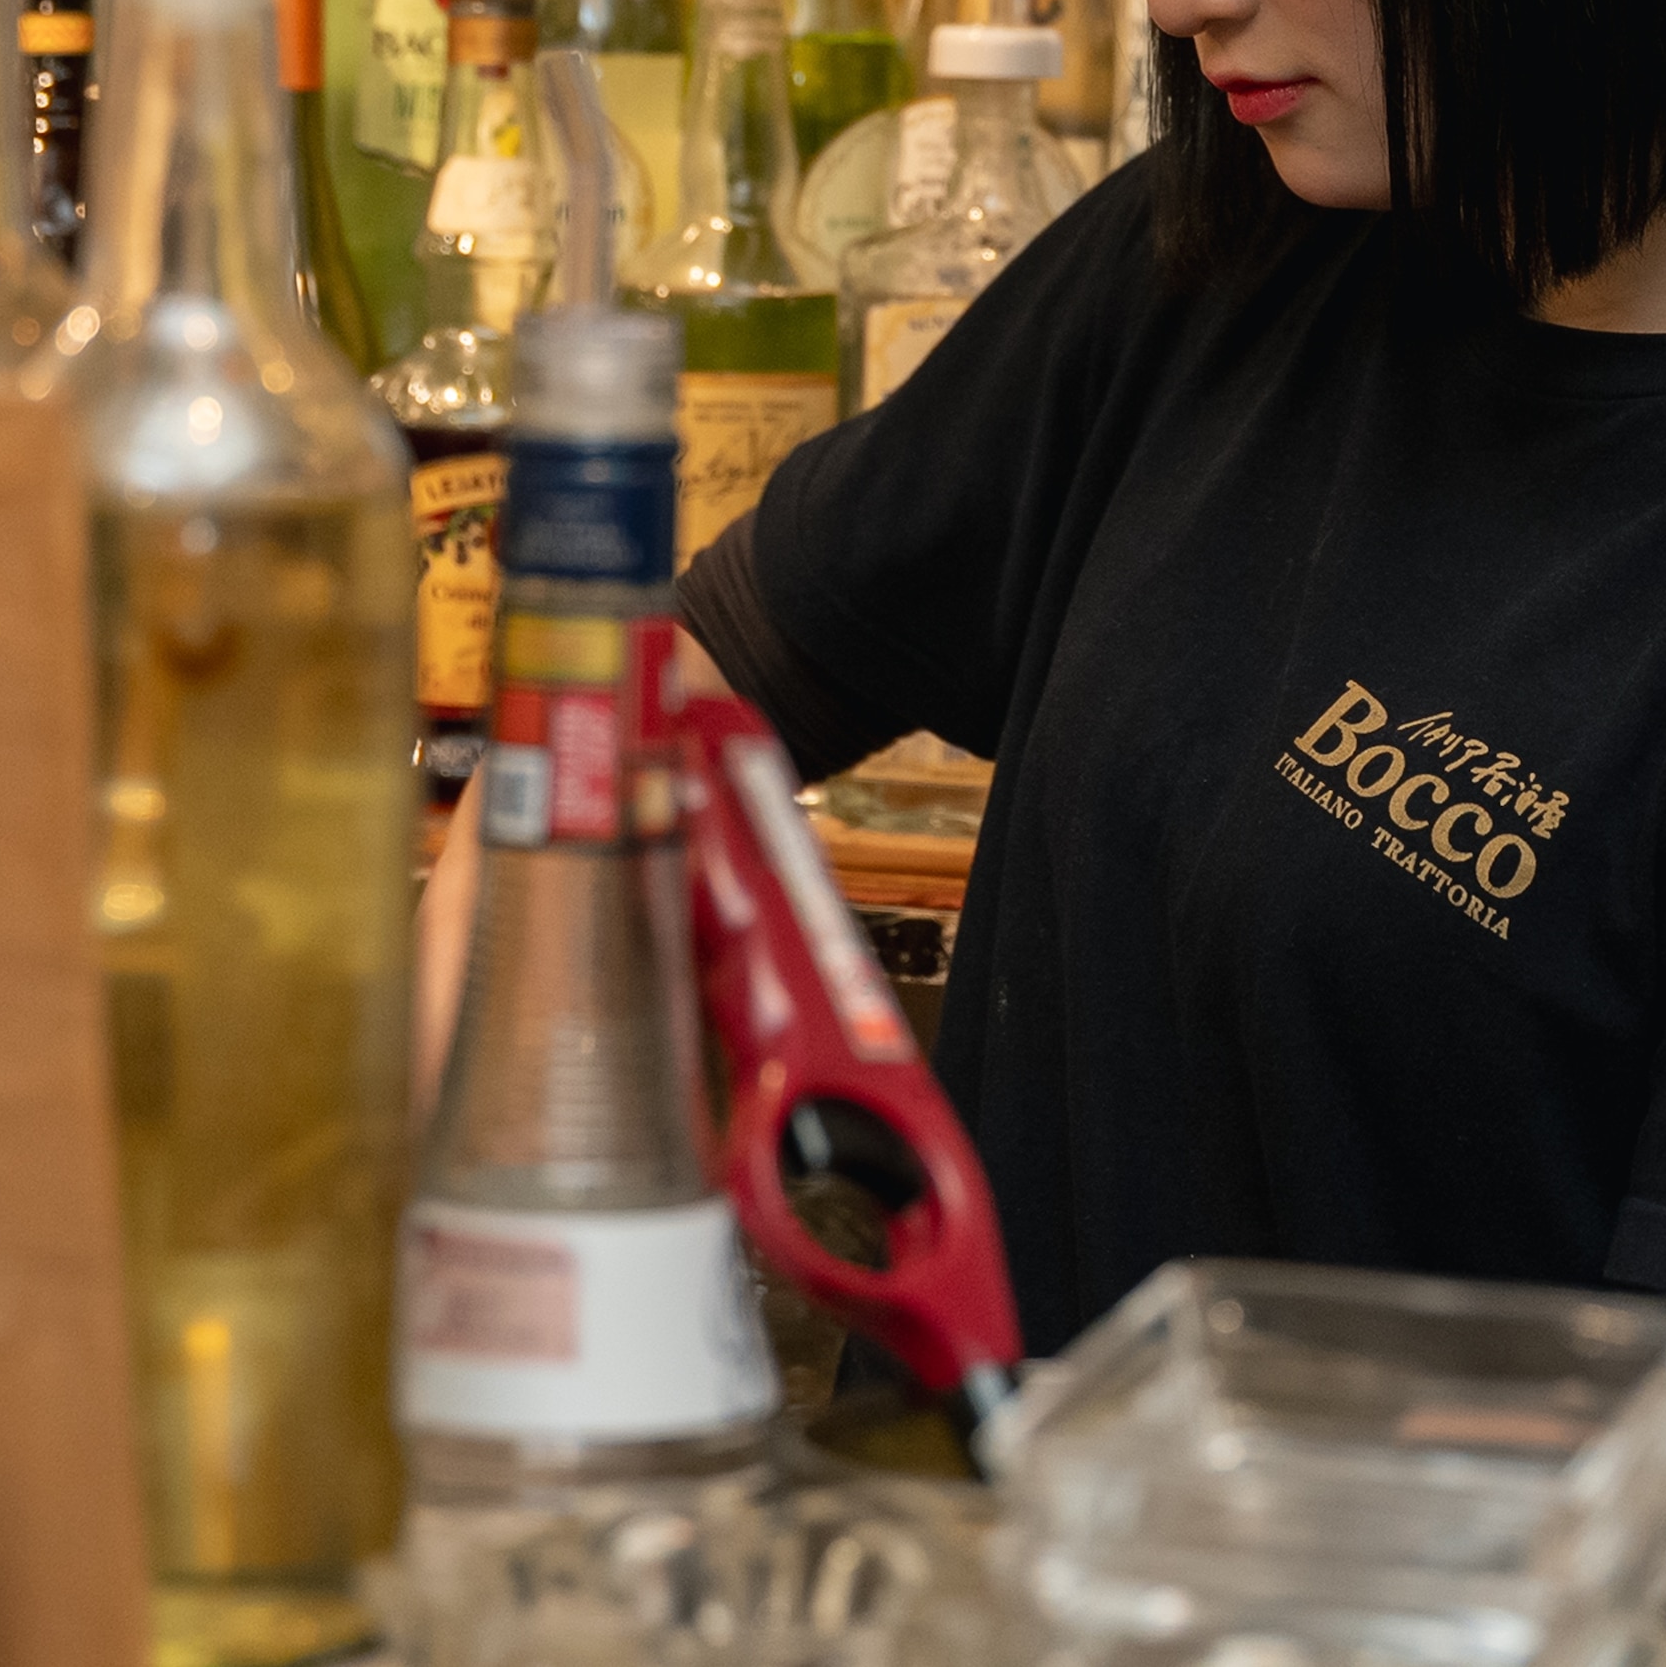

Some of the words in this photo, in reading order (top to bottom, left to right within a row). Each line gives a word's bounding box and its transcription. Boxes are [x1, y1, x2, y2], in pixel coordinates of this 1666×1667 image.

[1274, 752, 1364, 830] ITALIANO
[1371, 826, 1511, 940] TRATTORIA
[1293, 679, 1537, 899] BOCCO
